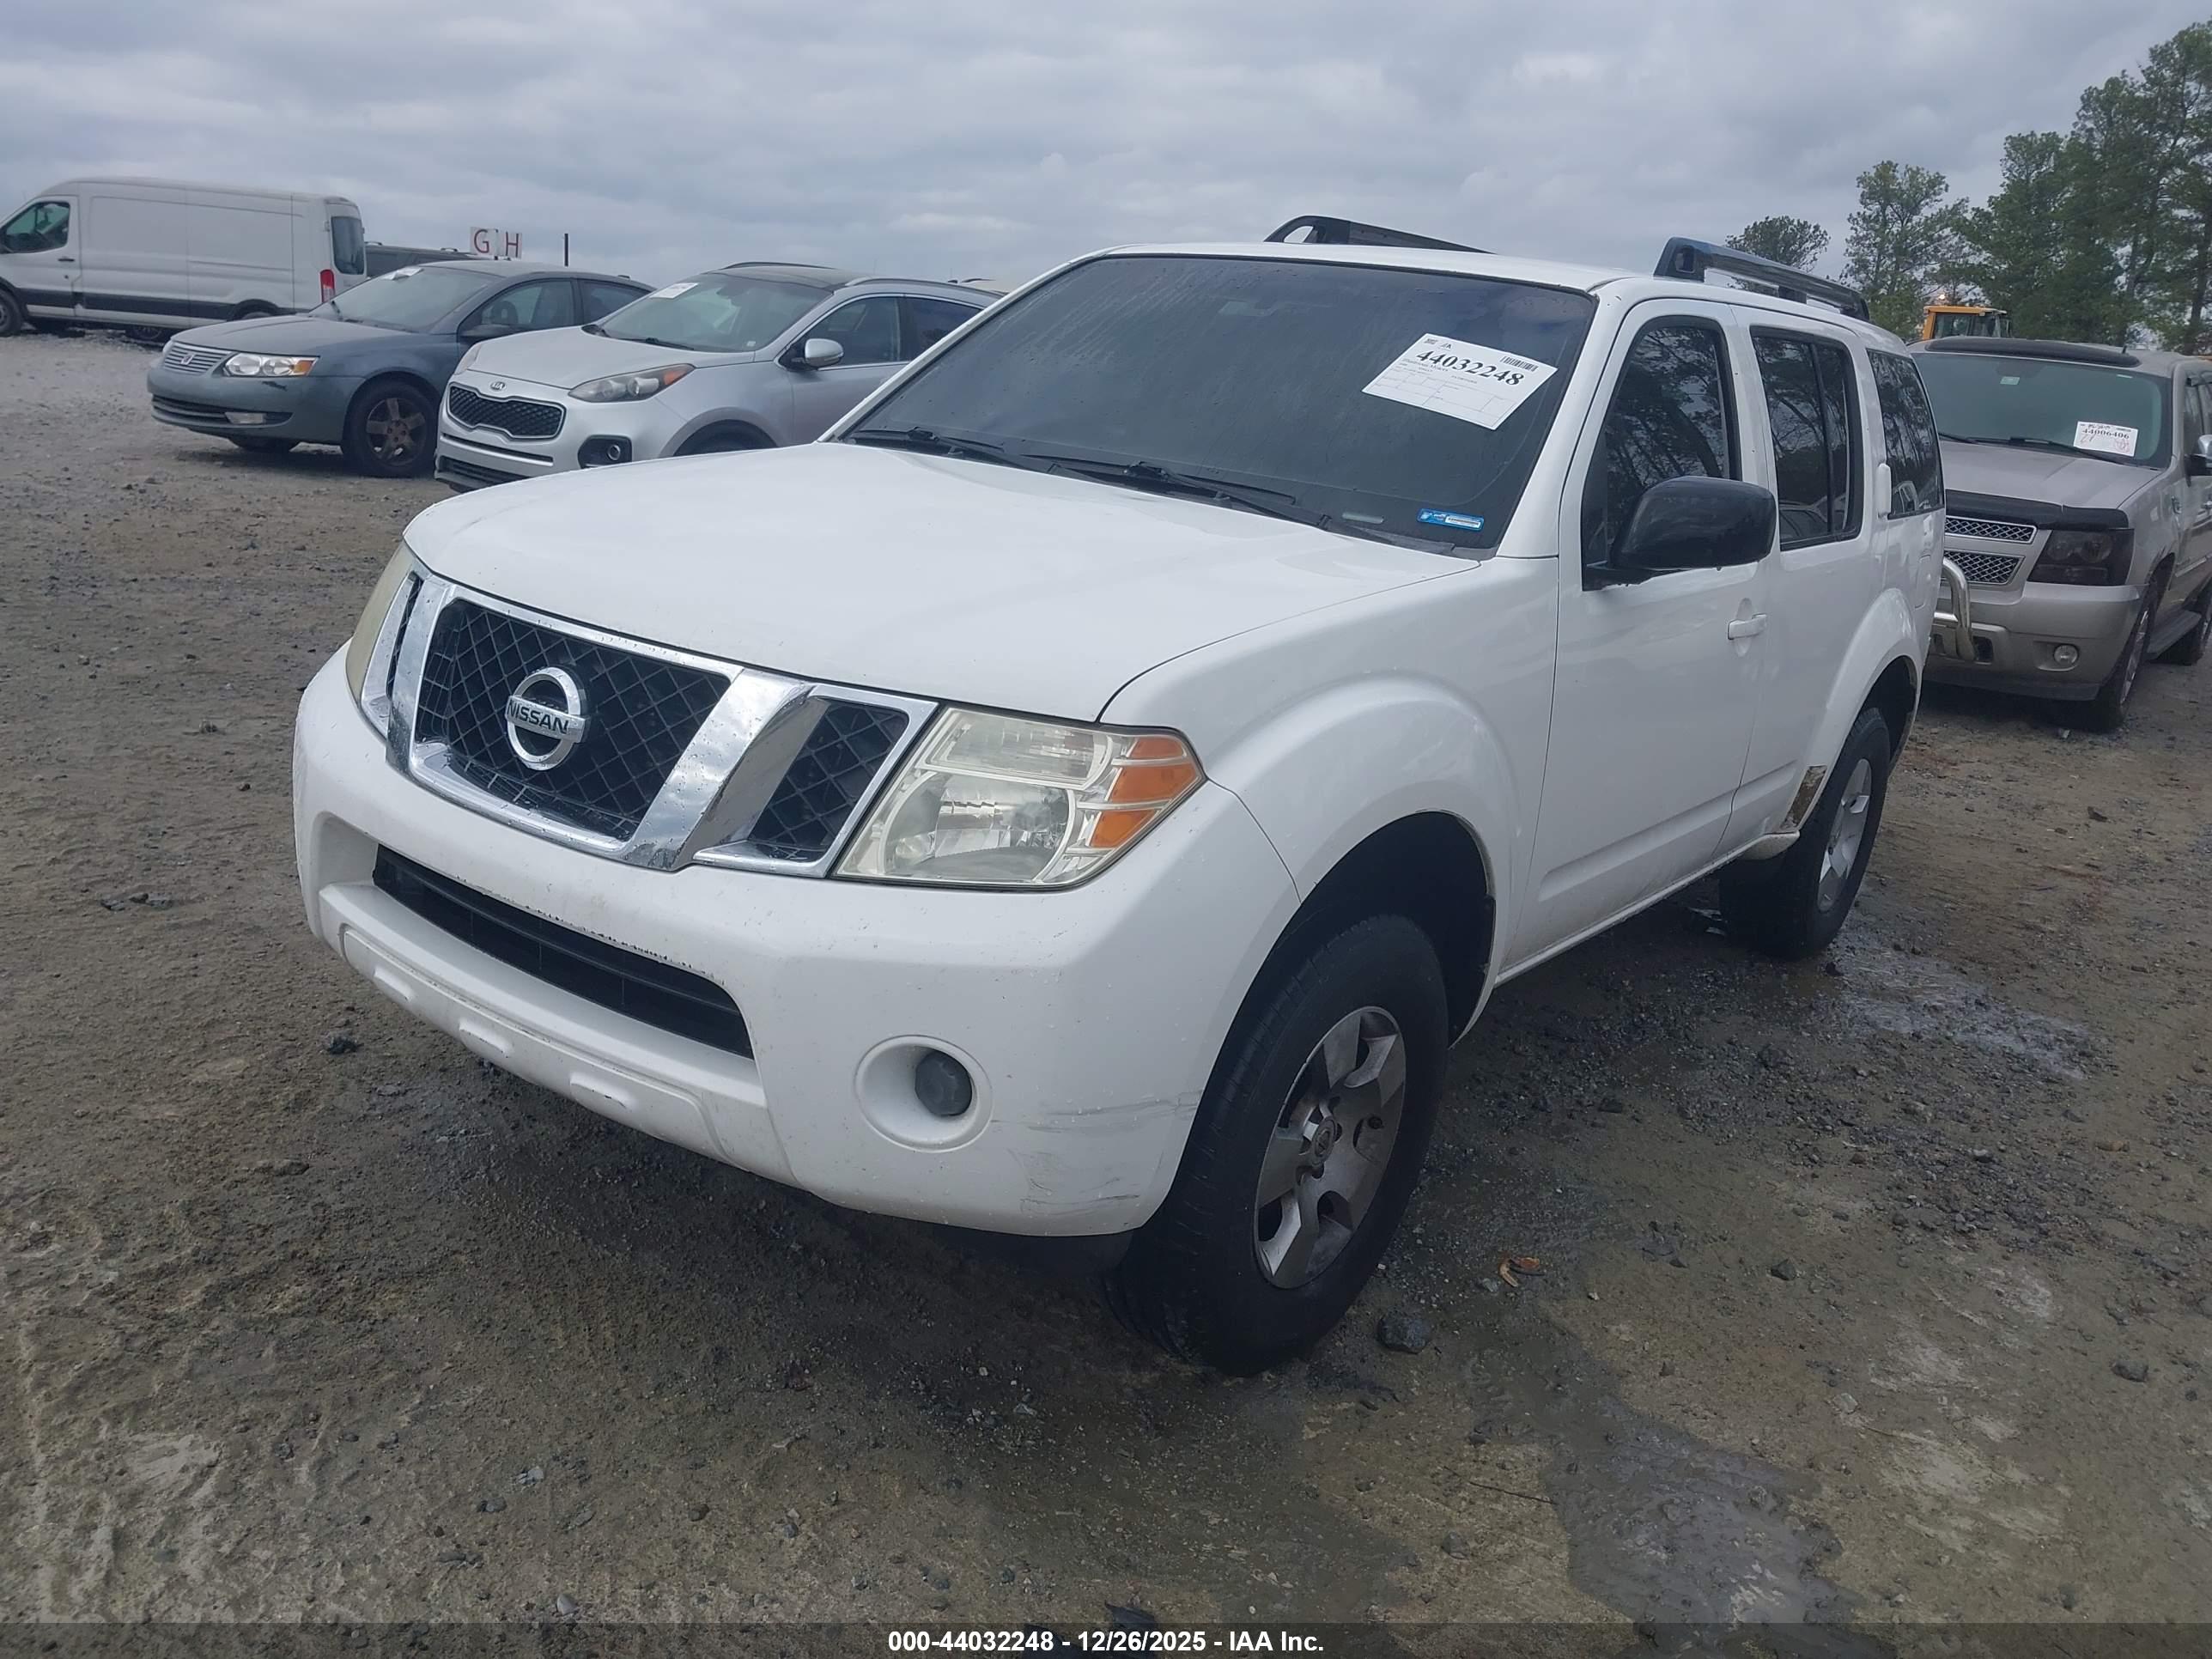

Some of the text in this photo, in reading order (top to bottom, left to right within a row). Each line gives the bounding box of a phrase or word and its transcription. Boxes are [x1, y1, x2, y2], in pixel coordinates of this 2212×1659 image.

[474, 228, 520, 258] G H
[1416, 350, 1525, 386] 44032248
[2081, 428, 2130, 440] 44006406
[507, 697, 569, 735] NISSAN
